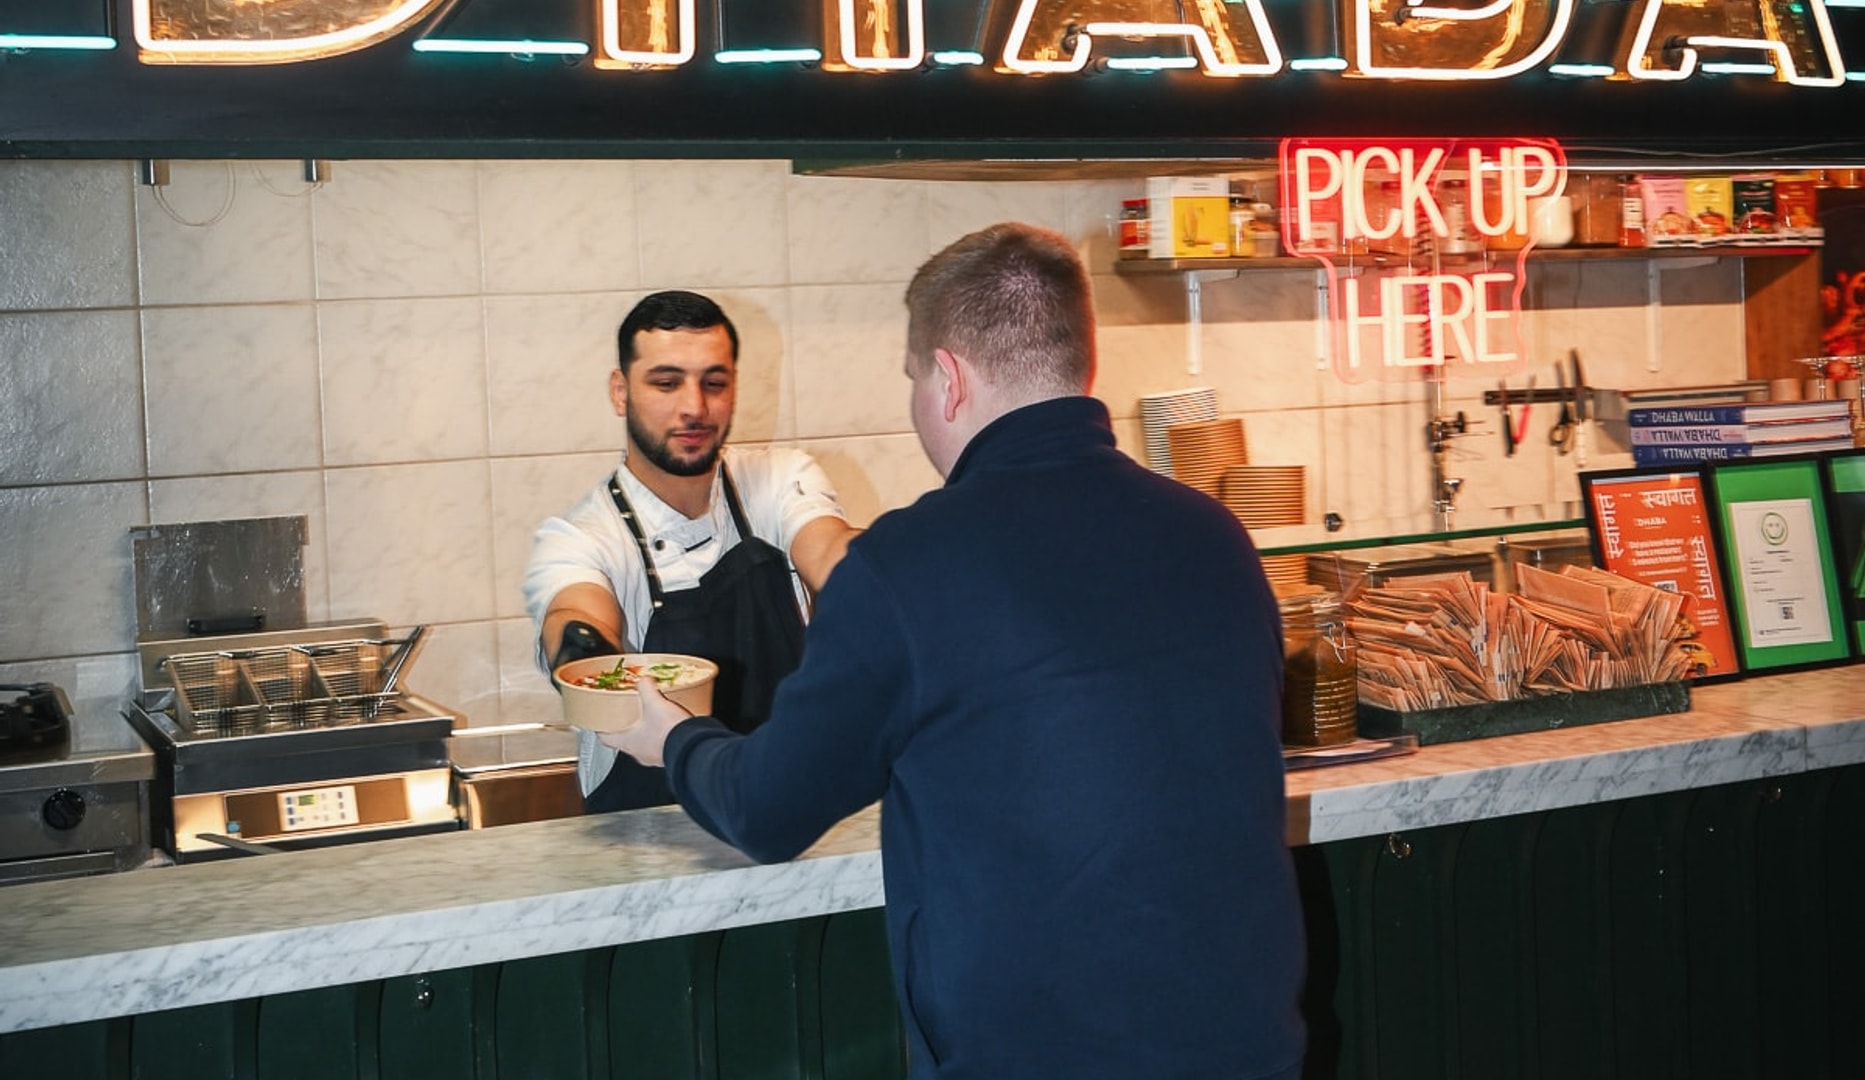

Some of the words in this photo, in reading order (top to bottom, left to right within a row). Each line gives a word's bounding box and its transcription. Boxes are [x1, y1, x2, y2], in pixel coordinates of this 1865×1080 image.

[1295, 146, 1449, 241] PICK
[1468, 146, 1556, 236] UP
[1345, 272, 1518, 368] HERE
